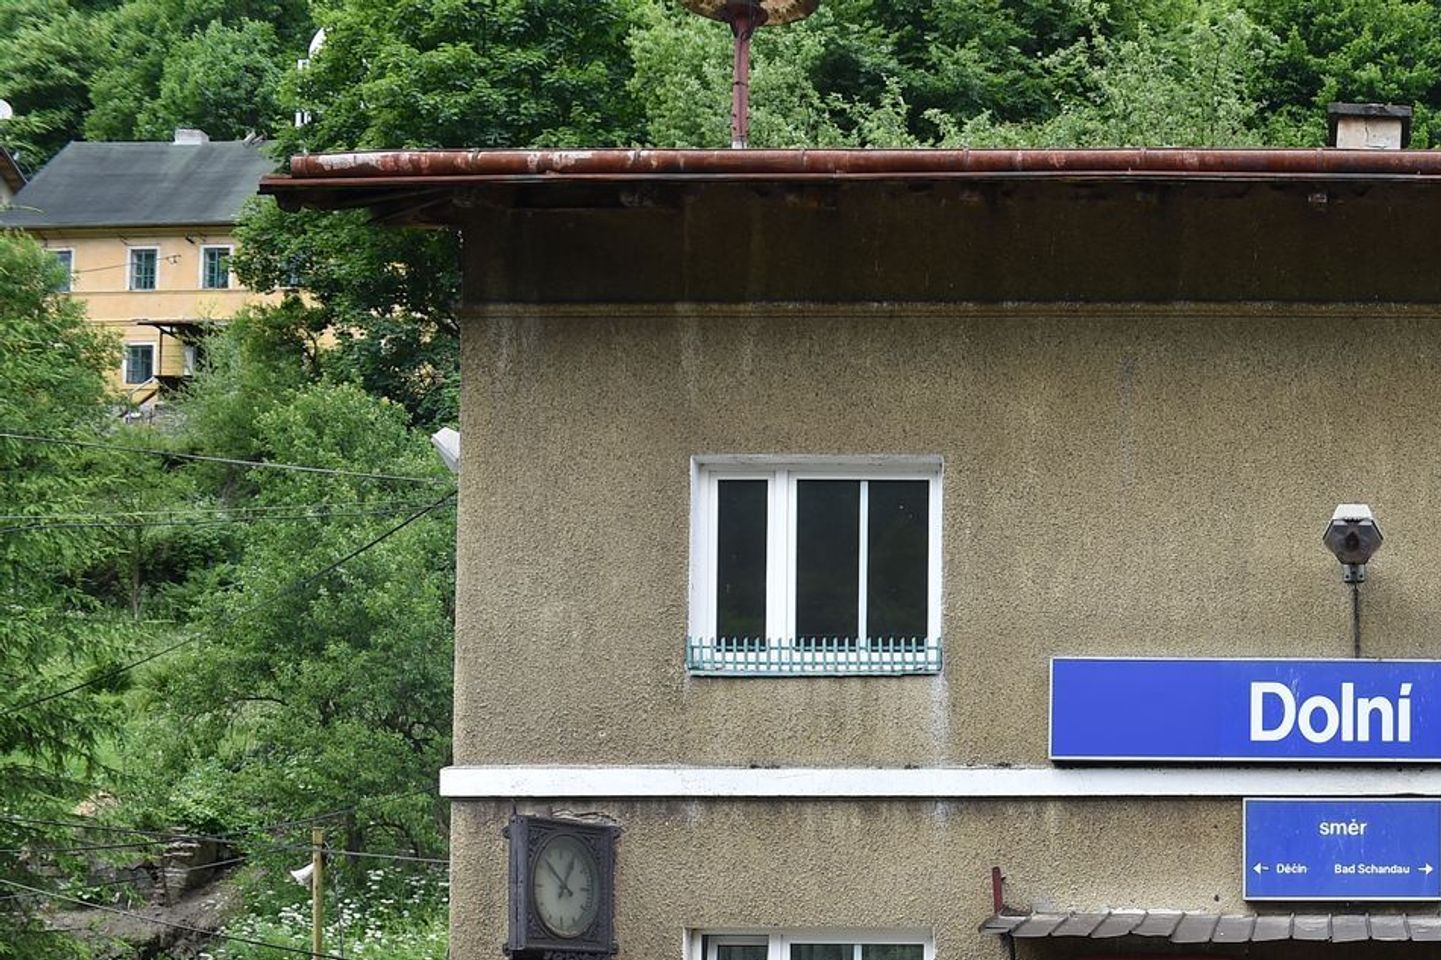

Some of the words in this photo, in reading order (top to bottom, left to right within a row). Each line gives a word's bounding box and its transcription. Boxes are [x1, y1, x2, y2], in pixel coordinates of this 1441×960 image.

[1250, 682, 1412, 744] Dolní
[1319, 818, 1368, 836] směr
[1334, 863, 1355, 875] Bad
[1358, 863, 1410, 875] Schandau
